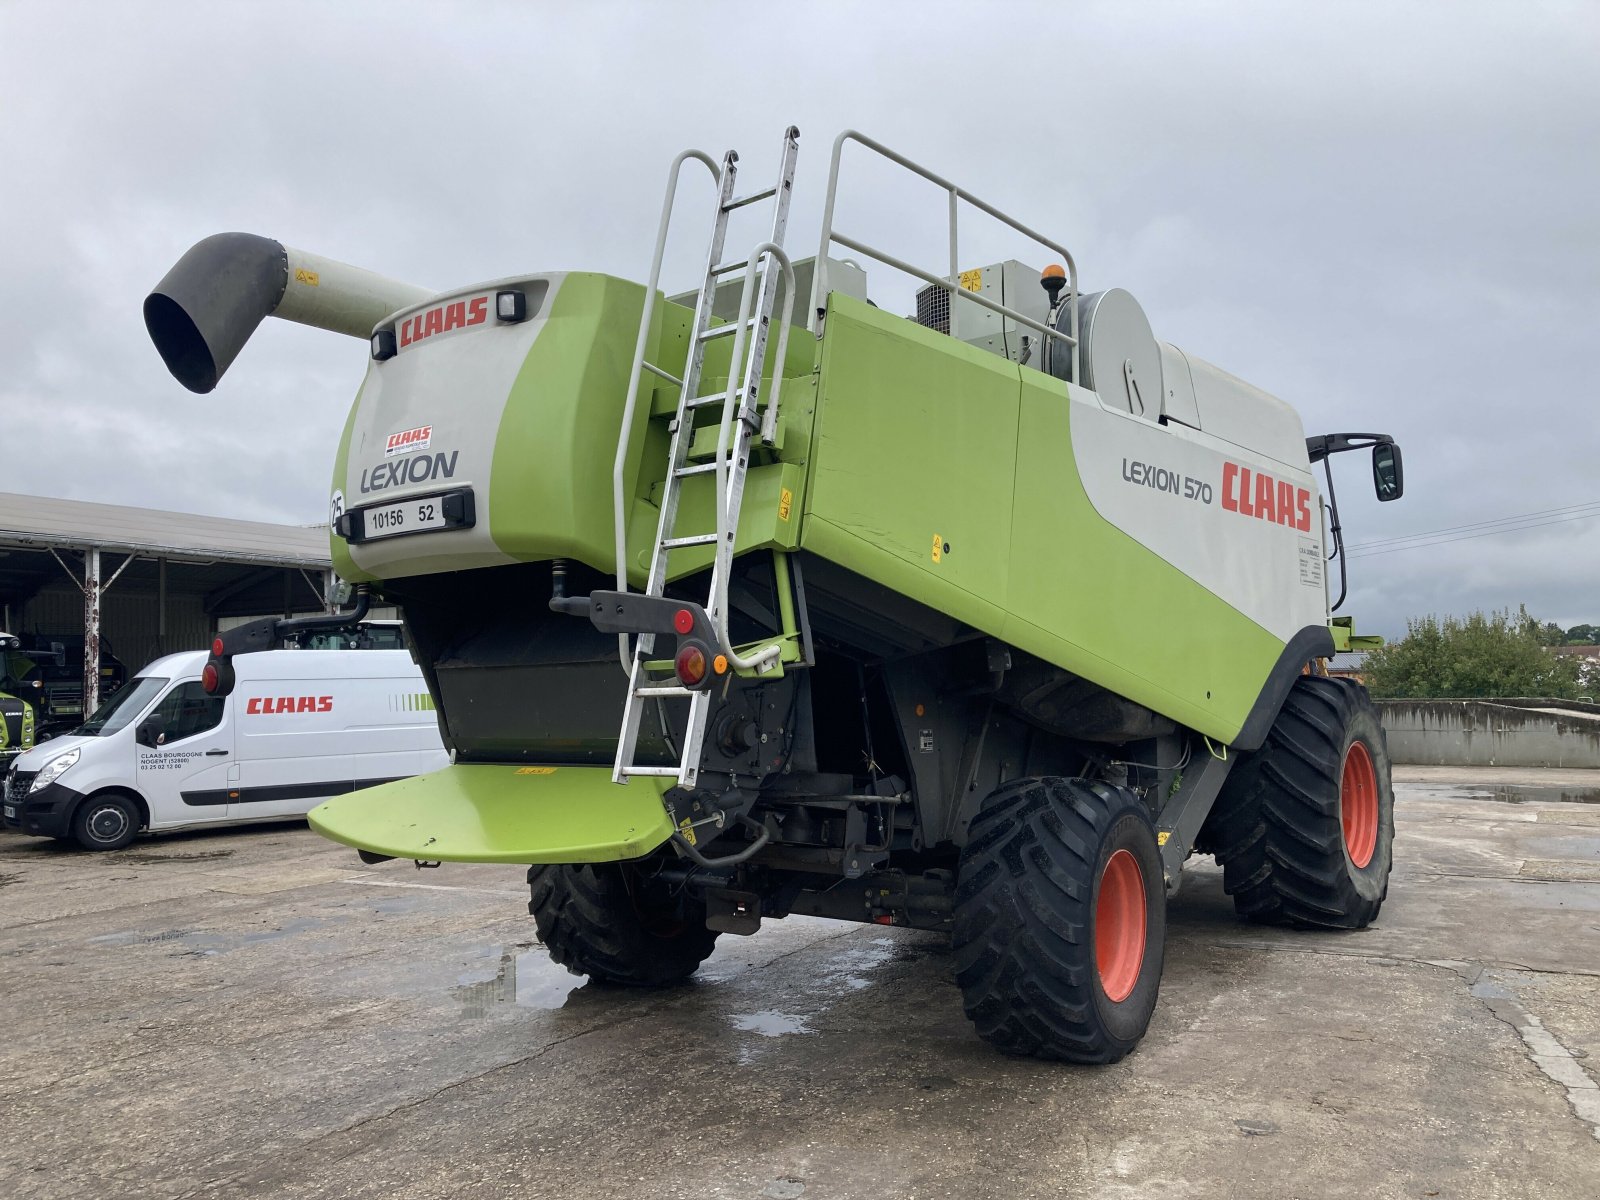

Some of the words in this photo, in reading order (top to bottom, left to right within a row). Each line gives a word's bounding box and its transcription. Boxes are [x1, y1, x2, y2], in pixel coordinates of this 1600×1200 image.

[400, 296, 488, 348] CLAAS
[388, 427, 432, 448] CLAAS
[360, 450, 459, 494] LEXION
[1122, 458, 1180, 495] LEXION
[1184, 477, 1213, 505] 570
[372, 509, 404, 529] 10156
[418, 504, 434, 522] 52
[1221, 461, 1311, 533] CLAAS
[246, 695, 334, 715] CLAAS
